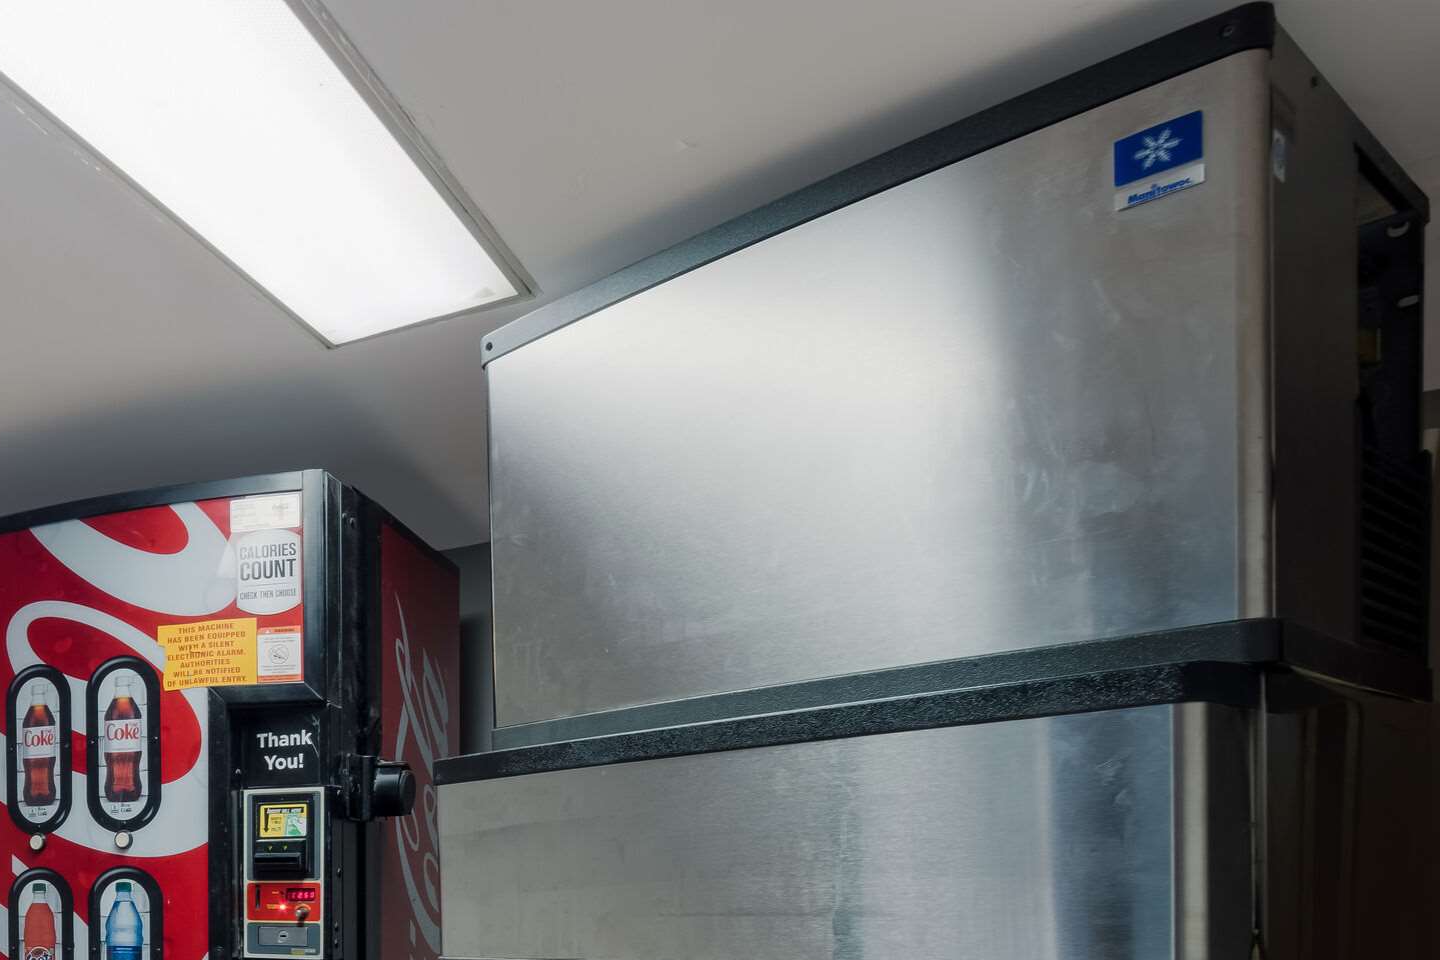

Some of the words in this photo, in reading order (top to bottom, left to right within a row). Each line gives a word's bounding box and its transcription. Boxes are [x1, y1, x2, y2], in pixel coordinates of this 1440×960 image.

[240, 542, 296, 560] CALORIES
[240, 559, 296, 581] COUNT
[240, 591, 258, 600] CHECK
[260, 590, 274, 599] THEN
[275, 588, 296, 597] CHOOSE
[198, 623, 233, 632] MACHINE
[185, 634, 204, 642] BEEN
[208, 631, 246, 639] EQUIPPED
[178, 643, 199, 651] WITH
[208, 640, 234, 648] SILENT
[168, 650, 214, 661] ELECTRONIC
[180, 658, 231, 668] AUTHORITIES
[206, 667, 240, 675] NOTIFIED
[179, 677, 219, 687] UNLAWFUL
[106, 723, 140, 741] Coke
[24, 730, 54, 748] Coke
[256, 729, 312, 748] Thank
[264, 753, 304, 771] You!
